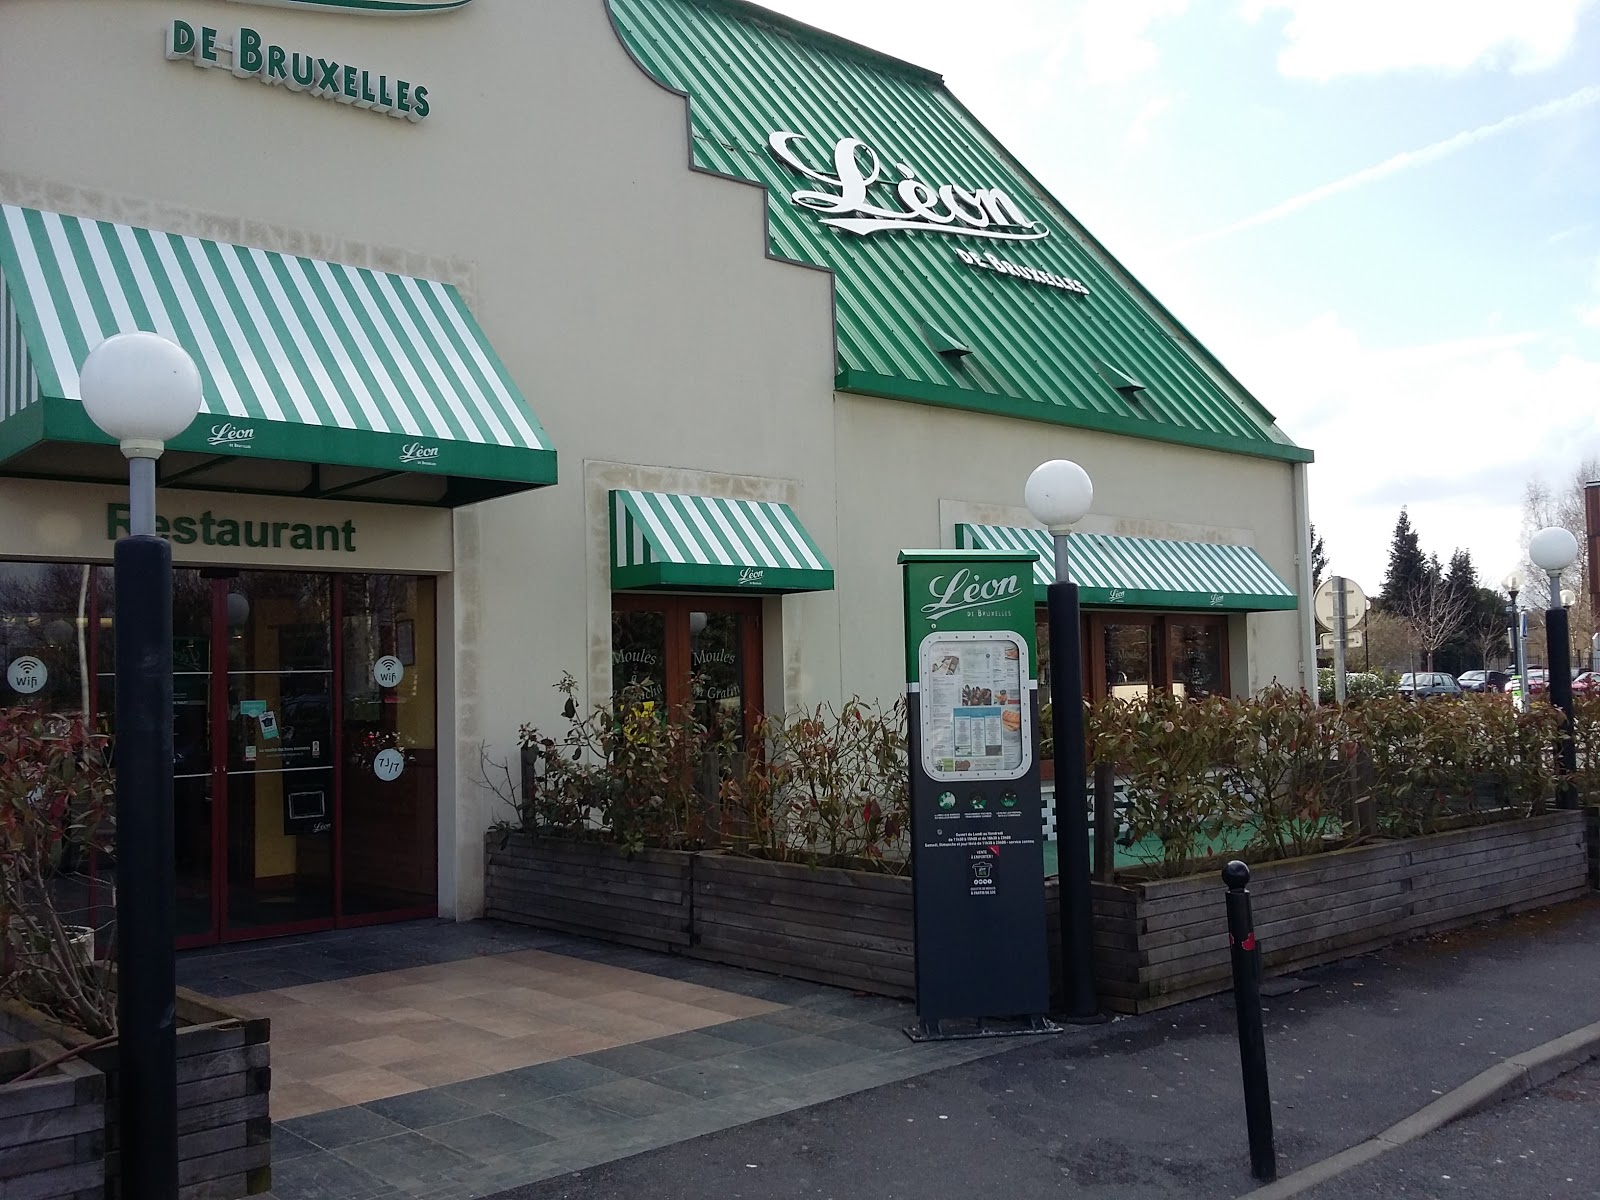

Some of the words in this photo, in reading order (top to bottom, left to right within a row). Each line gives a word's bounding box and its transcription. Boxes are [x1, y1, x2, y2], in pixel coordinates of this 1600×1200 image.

[170, 19, 218, 65] DE
[235, 27, 430, 120] BRUXELLES
[692, 649, 736, 666] Moules
[16, 676, 38, 688] Wifi
[380, 673, 397, 683] Wifi
